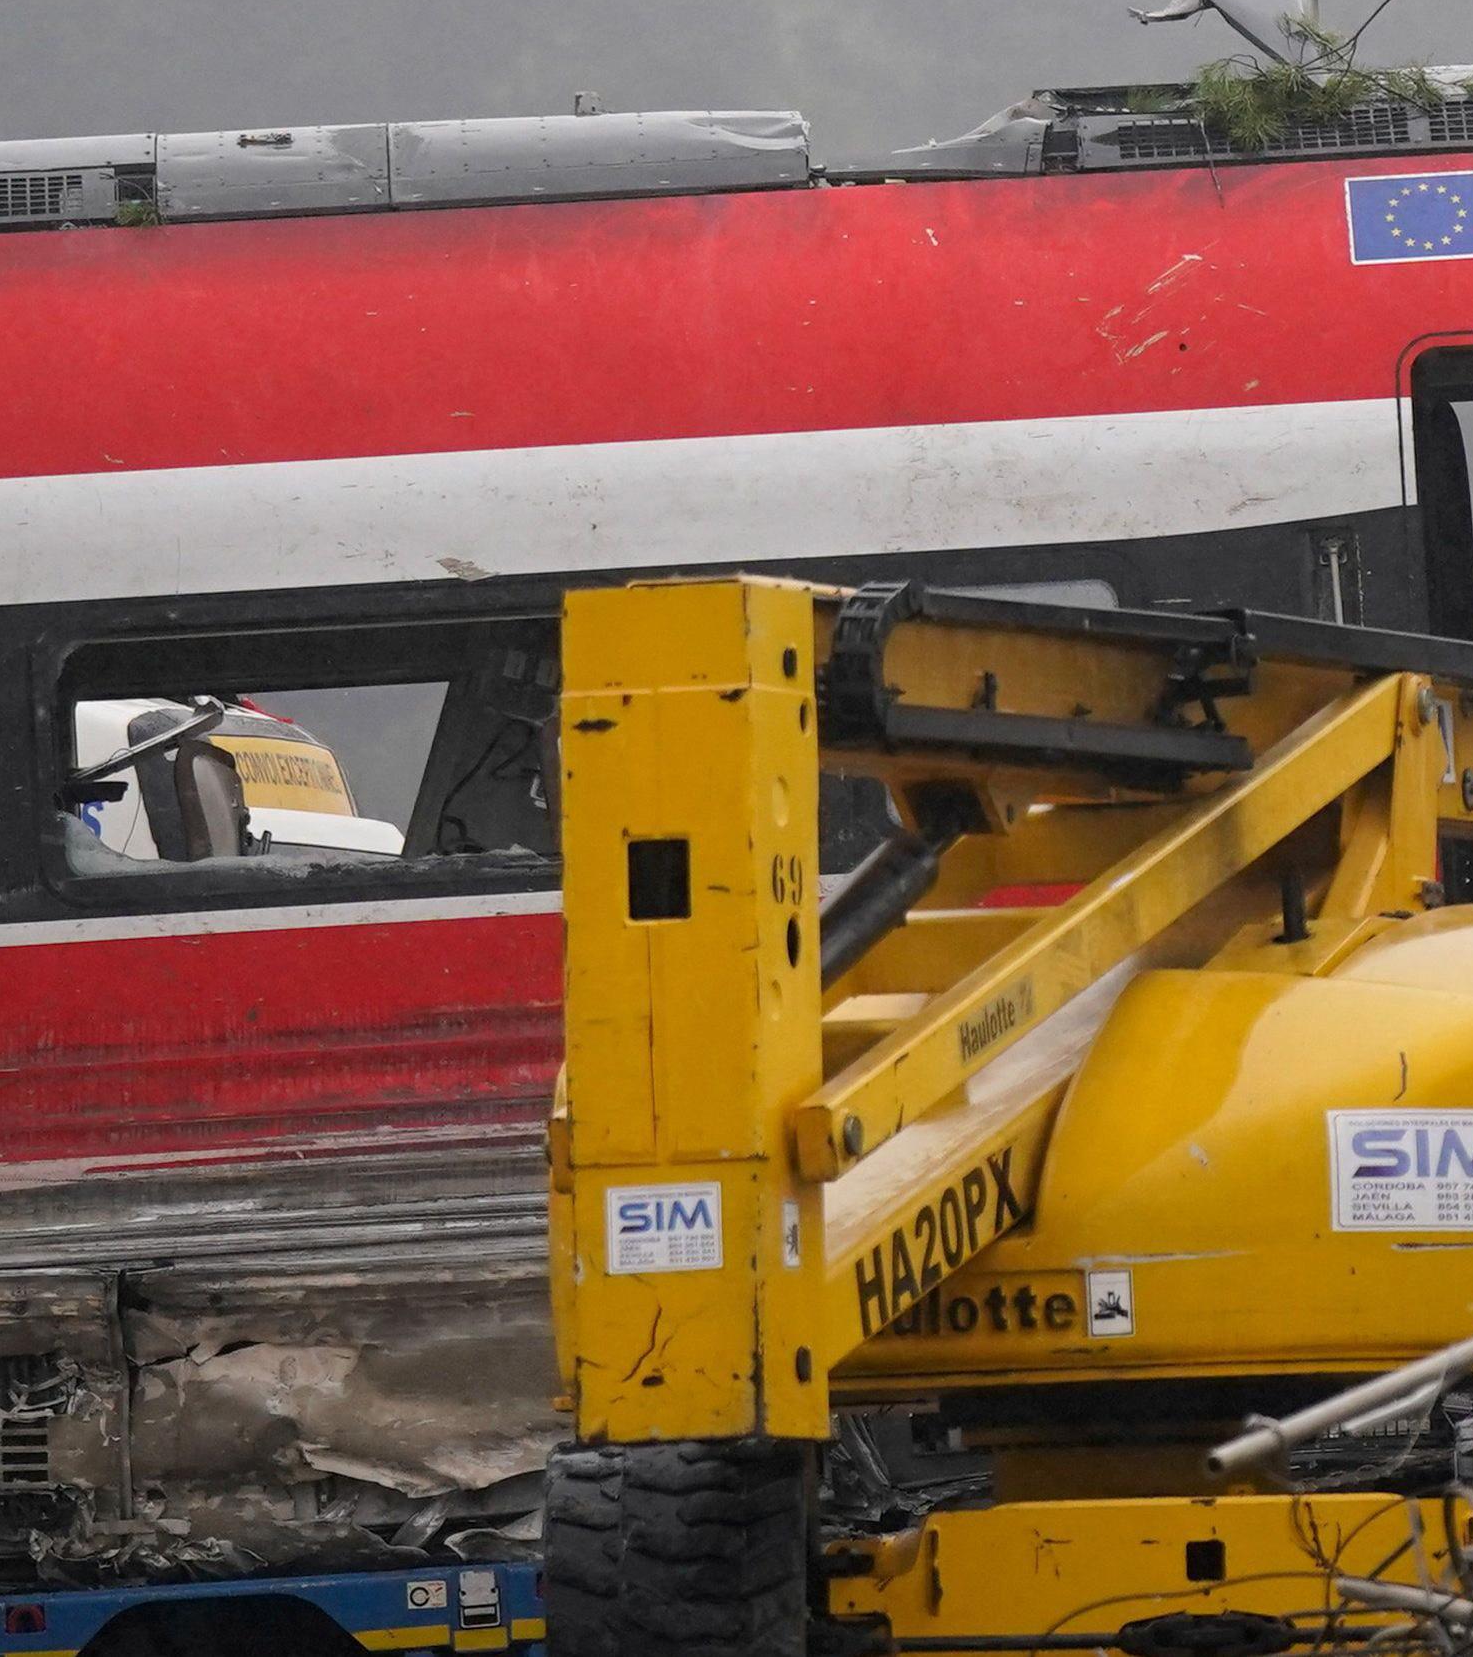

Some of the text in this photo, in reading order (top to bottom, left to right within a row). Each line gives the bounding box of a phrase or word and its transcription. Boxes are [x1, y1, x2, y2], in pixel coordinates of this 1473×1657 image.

[772, 853, 802, 905] 69
[958, 997, 1016, 1063] Haulotte
[619, 1198, 713, 1234] SIM
[1352, 1203, 1413, 1211] SEVILLA
[854, 1146, 1025, 1340] HA20PX
